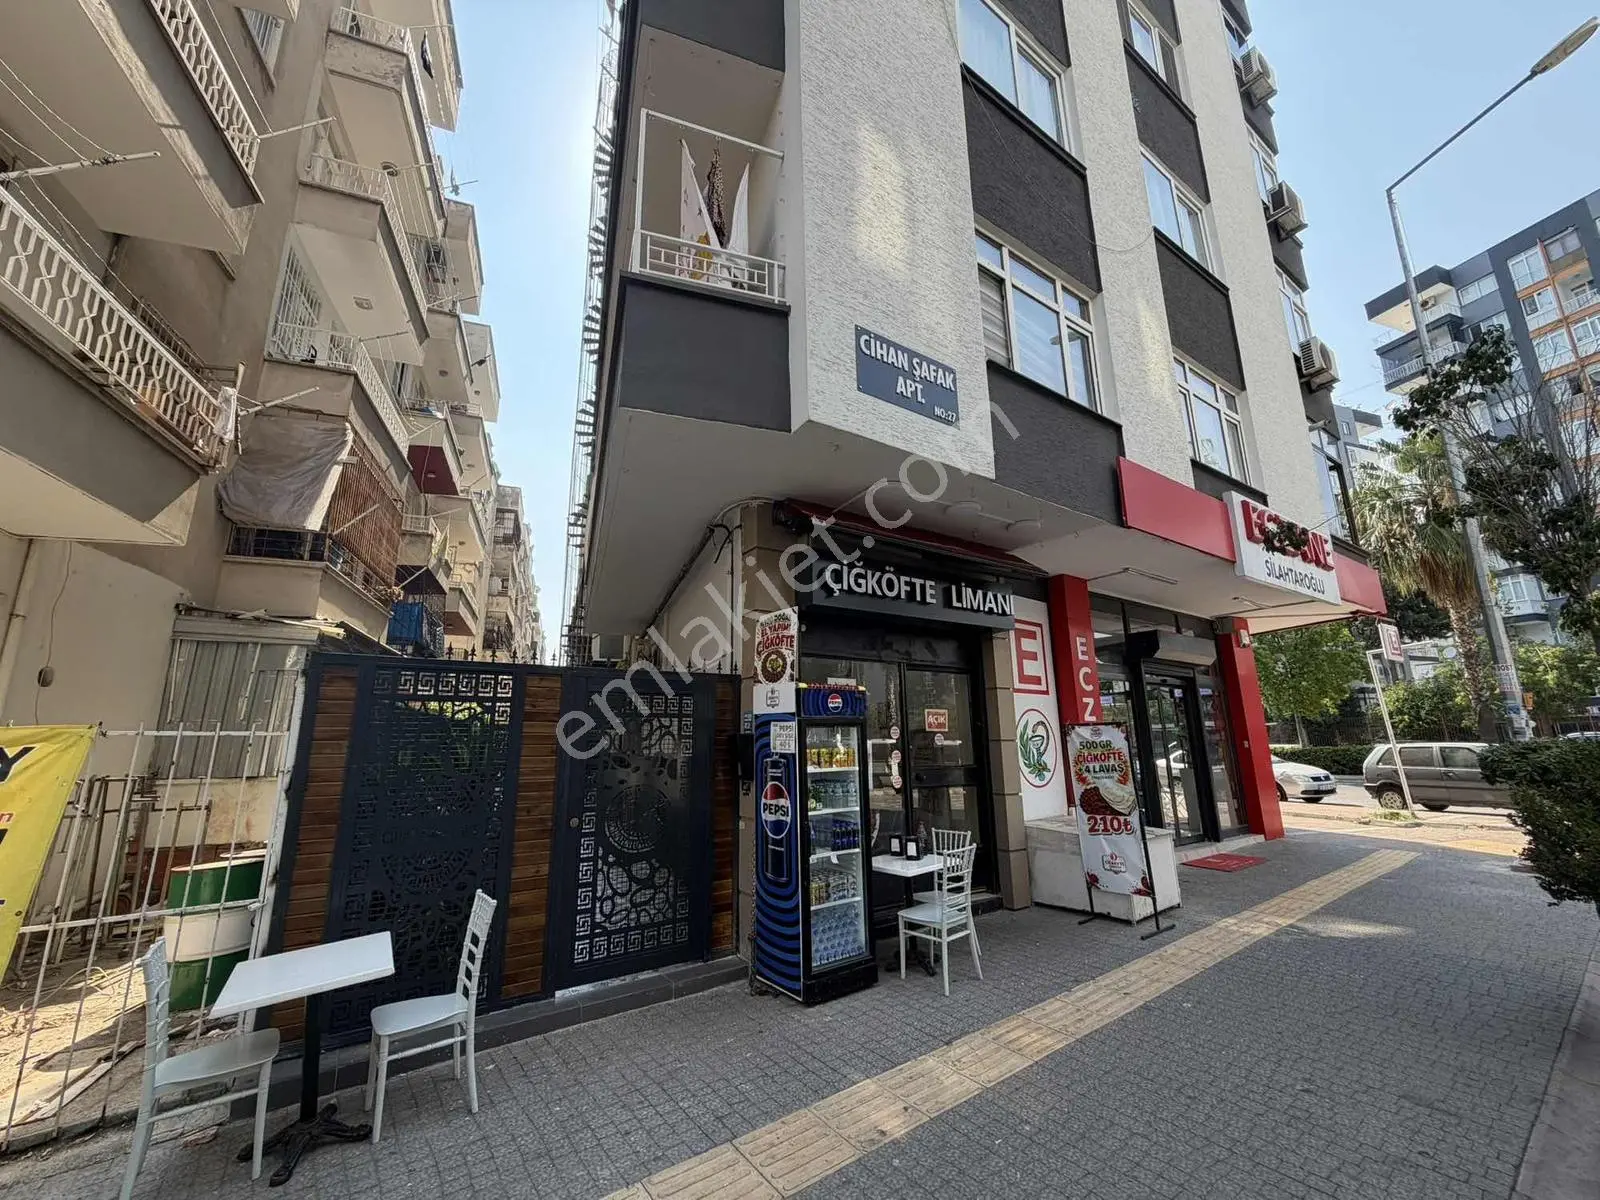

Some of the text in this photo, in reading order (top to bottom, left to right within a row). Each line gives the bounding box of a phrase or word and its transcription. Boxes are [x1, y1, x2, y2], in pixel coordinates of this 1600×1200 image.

[859, 333, 956, 391] CİHAN ŞAFAK
[896, 376, 926, 404] APT.
[934, 406, 956, 423] NO:27
[824, 561, 1014, 616] ÇİĞKÖFTE LİMANI
[1265, 557, 1325, 595] SİLAHTAROĞLU
[1014, 627, 1043, 686] E
[1079, 739, 1112, 750] 500 GR
[763, 802, 790, 817] PEPSI
